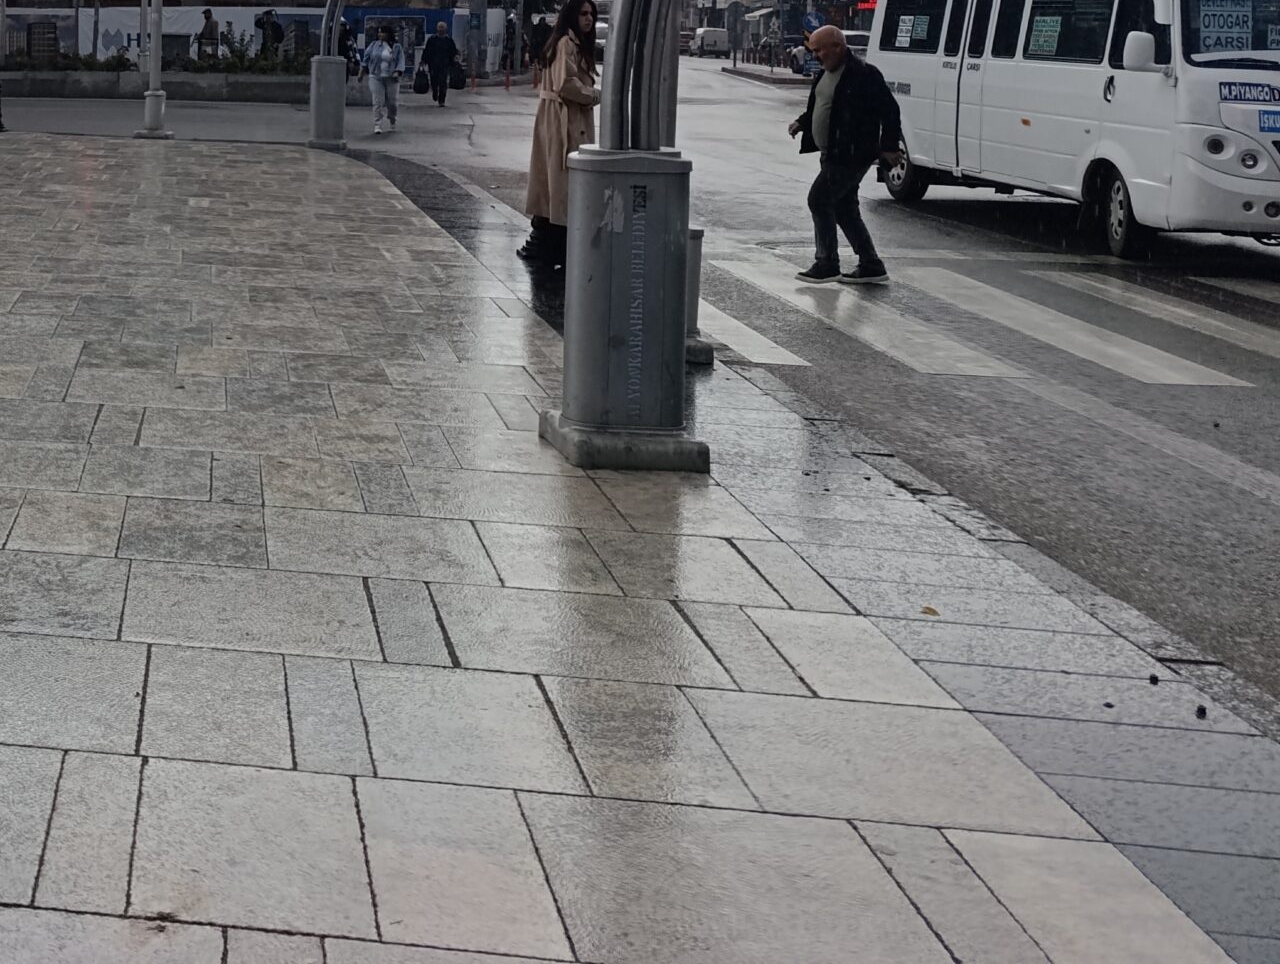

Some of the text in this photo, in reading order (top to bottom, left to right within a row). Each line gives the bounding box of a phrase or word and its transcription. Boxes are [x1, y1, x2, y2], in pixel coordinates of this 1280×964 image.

[1202, 13, 1250, 30] OTOGAR
[1202, 35, 1249, 51] ÇARŞI
[1220, 83, 1271, 101] M.PİYANGO
